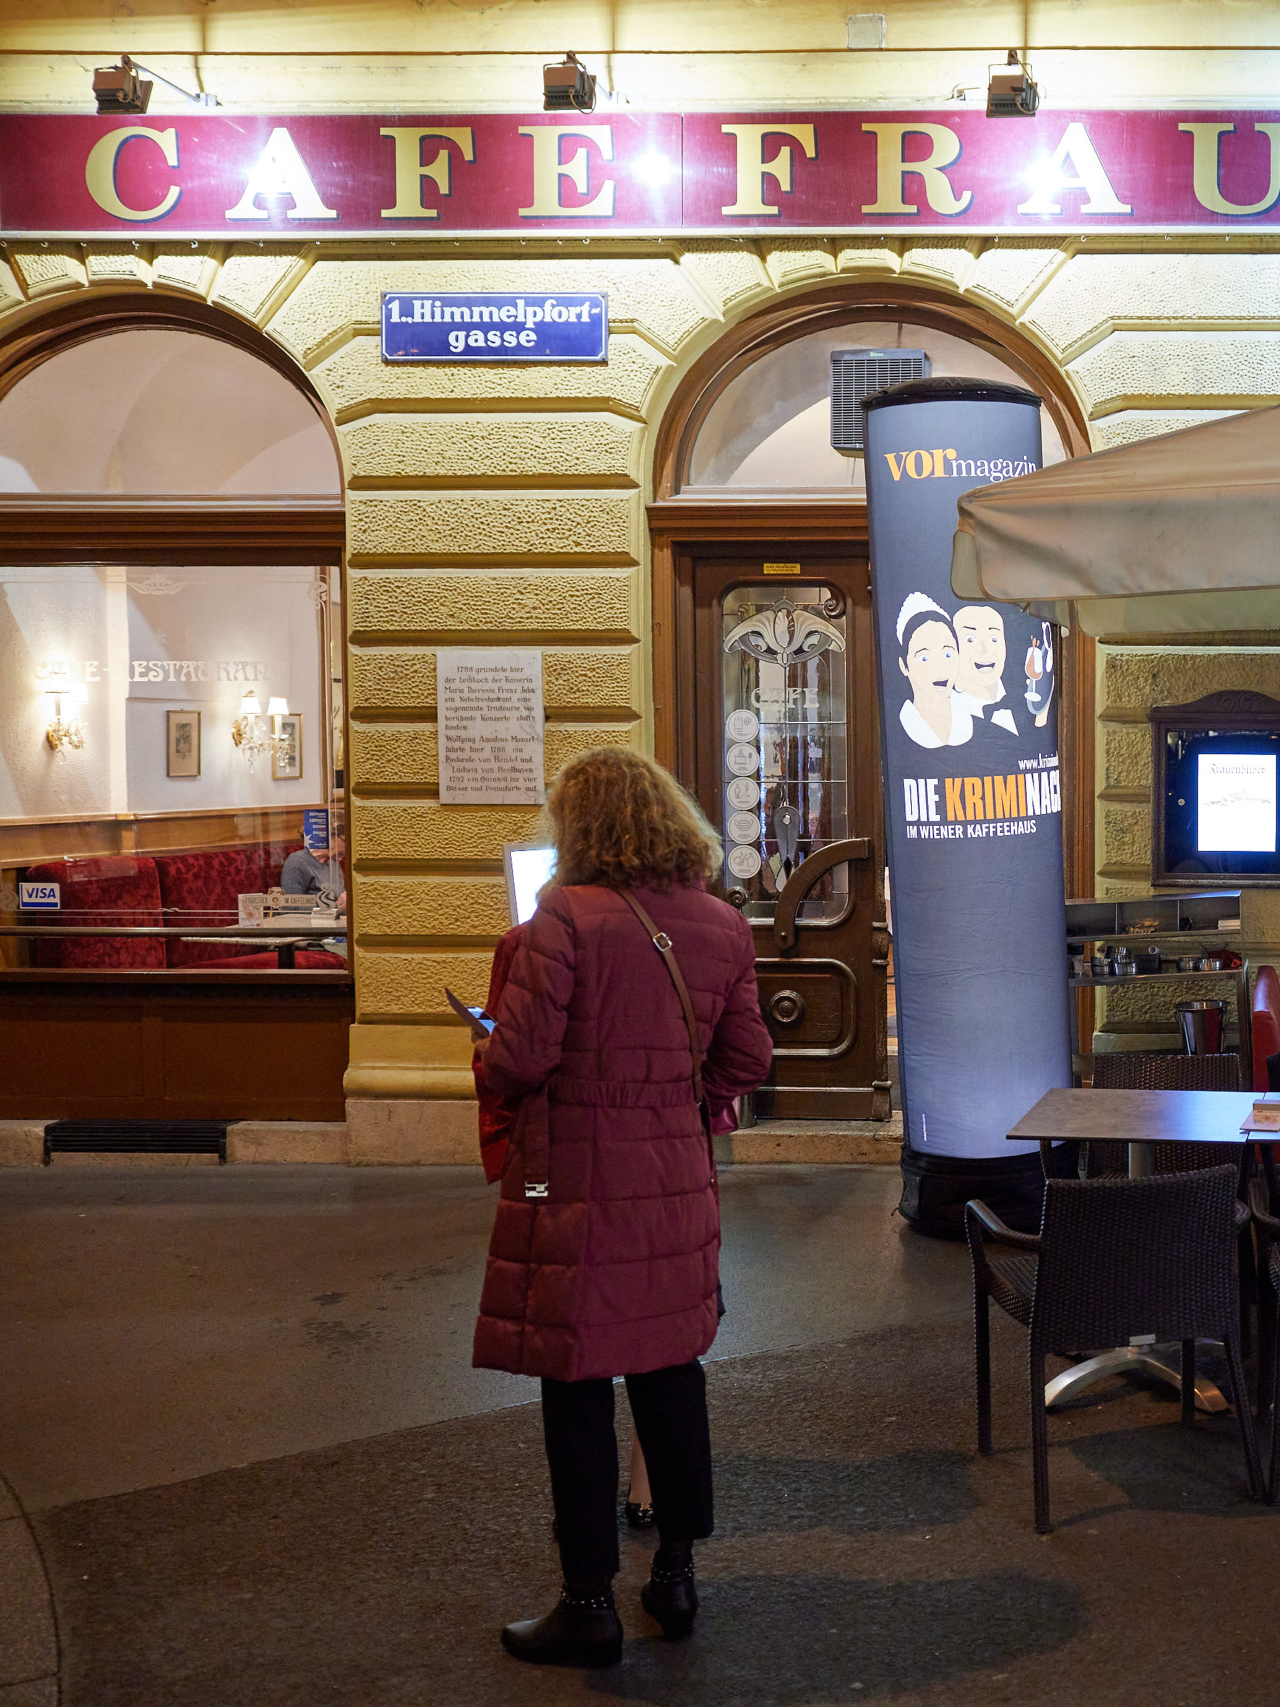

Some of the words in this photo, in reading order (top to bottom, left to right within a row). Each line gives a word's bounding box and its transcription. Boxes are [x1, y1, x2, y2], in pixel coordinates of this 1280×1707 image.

[85, 123, 616, 223] CAFE
[448, 329, 537, 353] gasse
[480, 714, 511, 722] Konzerte
[445, 735, 476, 744] Wolfgang
[903, 778, 941, 821] DIE
[906, 825, 918, 839] IM
[919, 824, 964, 839] WIENER
[967, 819, 1037, 838] KAFFEEHAUS
[25, 888, 57, 899] VISA
